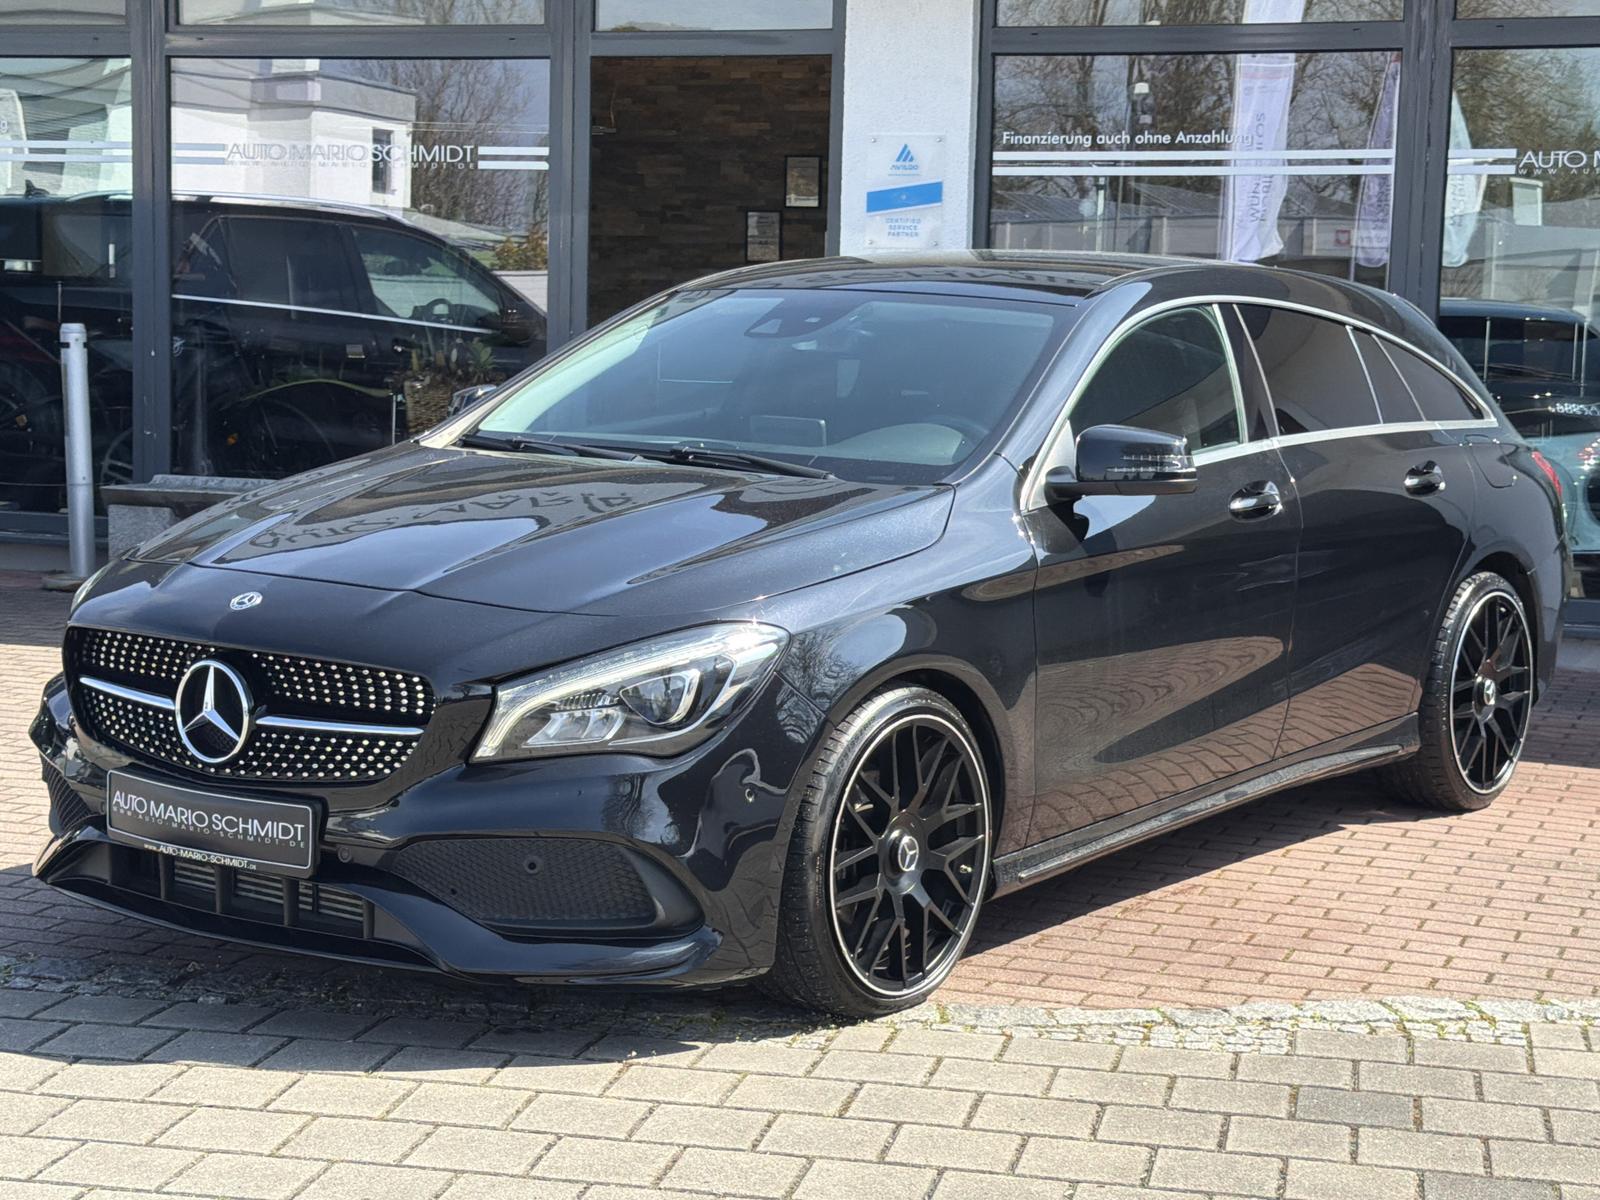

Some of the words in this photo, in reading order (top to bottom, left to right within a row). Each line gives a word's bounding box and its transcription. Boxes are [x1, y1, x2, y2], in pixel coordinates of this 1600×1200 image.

[1002, 131, 1092, 147] Finanzierung
[1097, 131, 1131, 145] auch
[1134, 131, 1172, 145] ohne
[371, 144, 474, 162] SCHMIDT
[1518, 150, 1587, 169] AUTO
[112, 790, 147, 814] AUTO
[149, 800, 209, 828] MARIO
[211, 813, 305, 841] SCHMIDT
